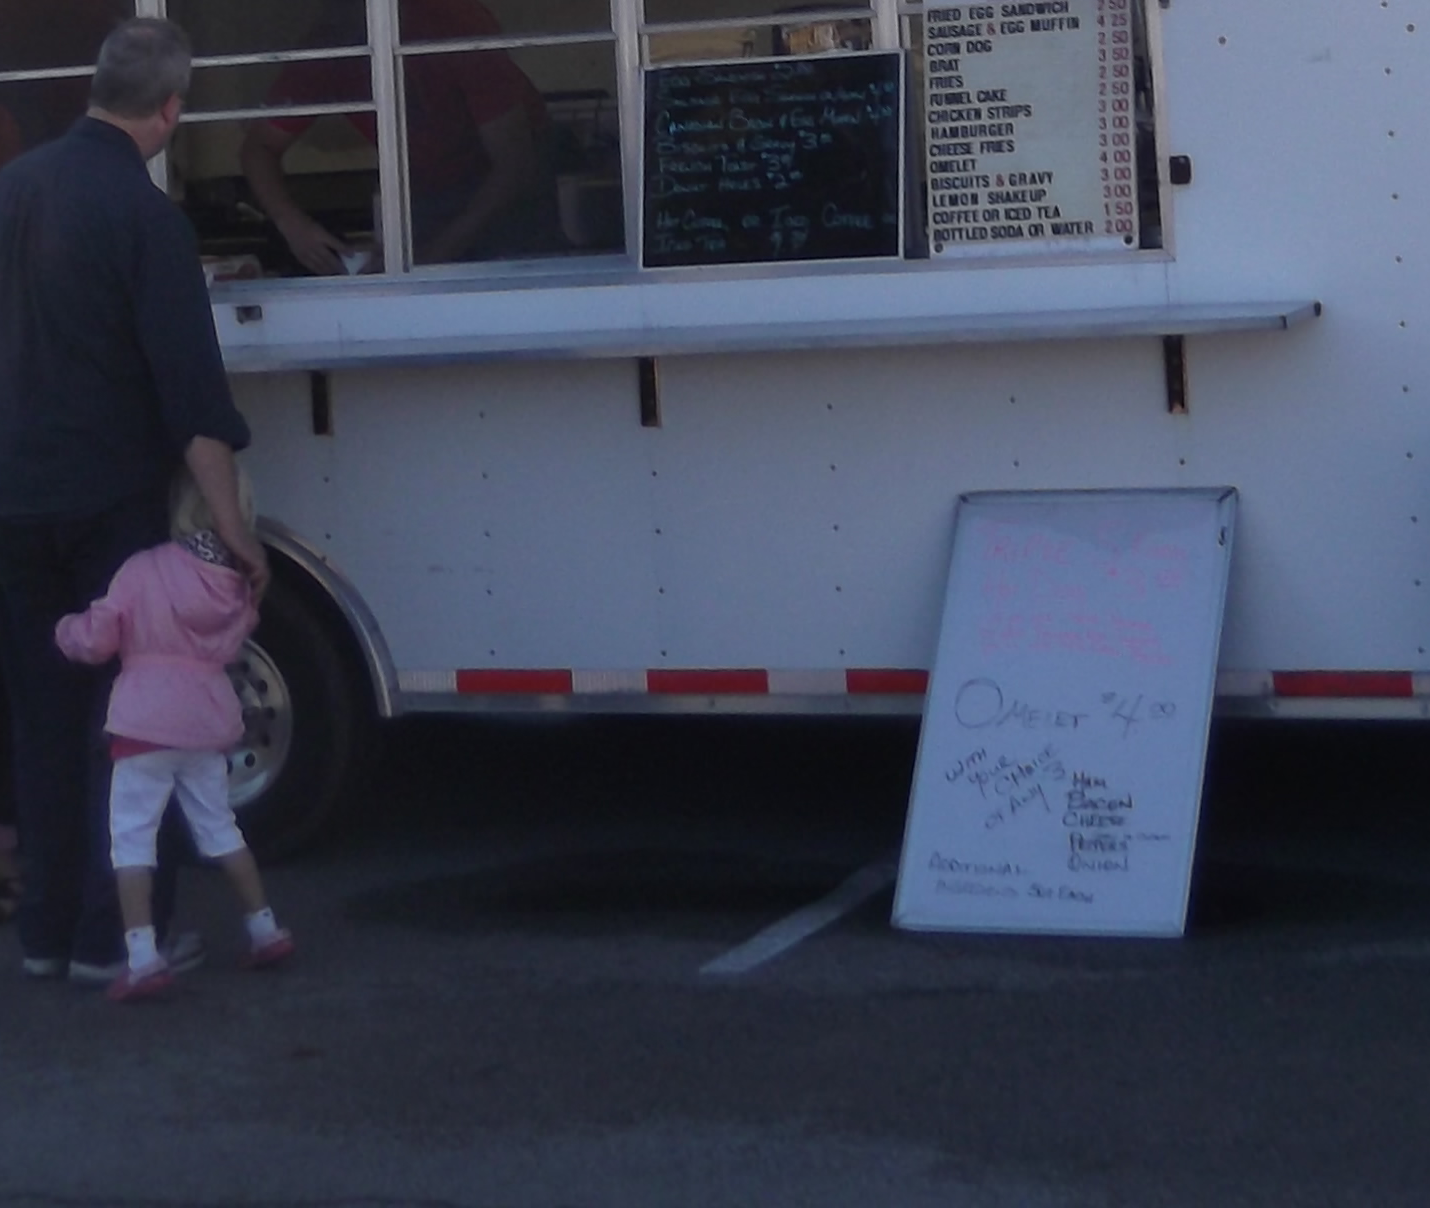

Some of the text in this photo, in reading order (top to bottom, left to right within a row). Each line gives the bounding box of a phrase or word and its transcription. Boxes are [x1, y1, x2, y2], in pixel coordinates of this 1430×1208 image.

[928, 9, 961, 22] FRIED
[969, 6, 994, 20] EGG
[1001, 1, 1068, 17] SANDWICH
[928, 24, 981, 39] SAUSAGE
[1000, 21, 1025, 34] EGG
[1030, 16, 1079, 32] MUFFIN
[927, 43, 960, 56] CORN
[966, 40, 992, 53] DOG
[930, 60, 959, 73] BRAT
[930, 76, 963, 89] FRIES
[930, 92, 971, 105] FUNNEL
[977, 89, 1007, 102] CAKE
[929, 108, 982, 123] CHICKEN
[988, 104, 1031, 119] STRIPS
[931, 123, 1014, 140] HAMBURGER
[930, 143, 971, 157] CHEESE
[980, 140, 1015, 153] FRIES
[930, 159, 976, 173] OMELET
[931, 175, 990, 190] BISCUITS
[1009, 171, 1054, 186] GRAVY
[933, 192, 979, 207] LEMON
[933, 209, 979, 224] COFFEE
[983, 208, 1000, 221] OR
[1004, 206, 1031, 220] ICED
[1037, 205, 1061, 218] TEA
[934, 227, 987, 242] BOTTLED
[990, 225, 1024, 238] SODA
[1029, 224, 1044, 237] OR
[1051, 221, 1094, 235] WATER
